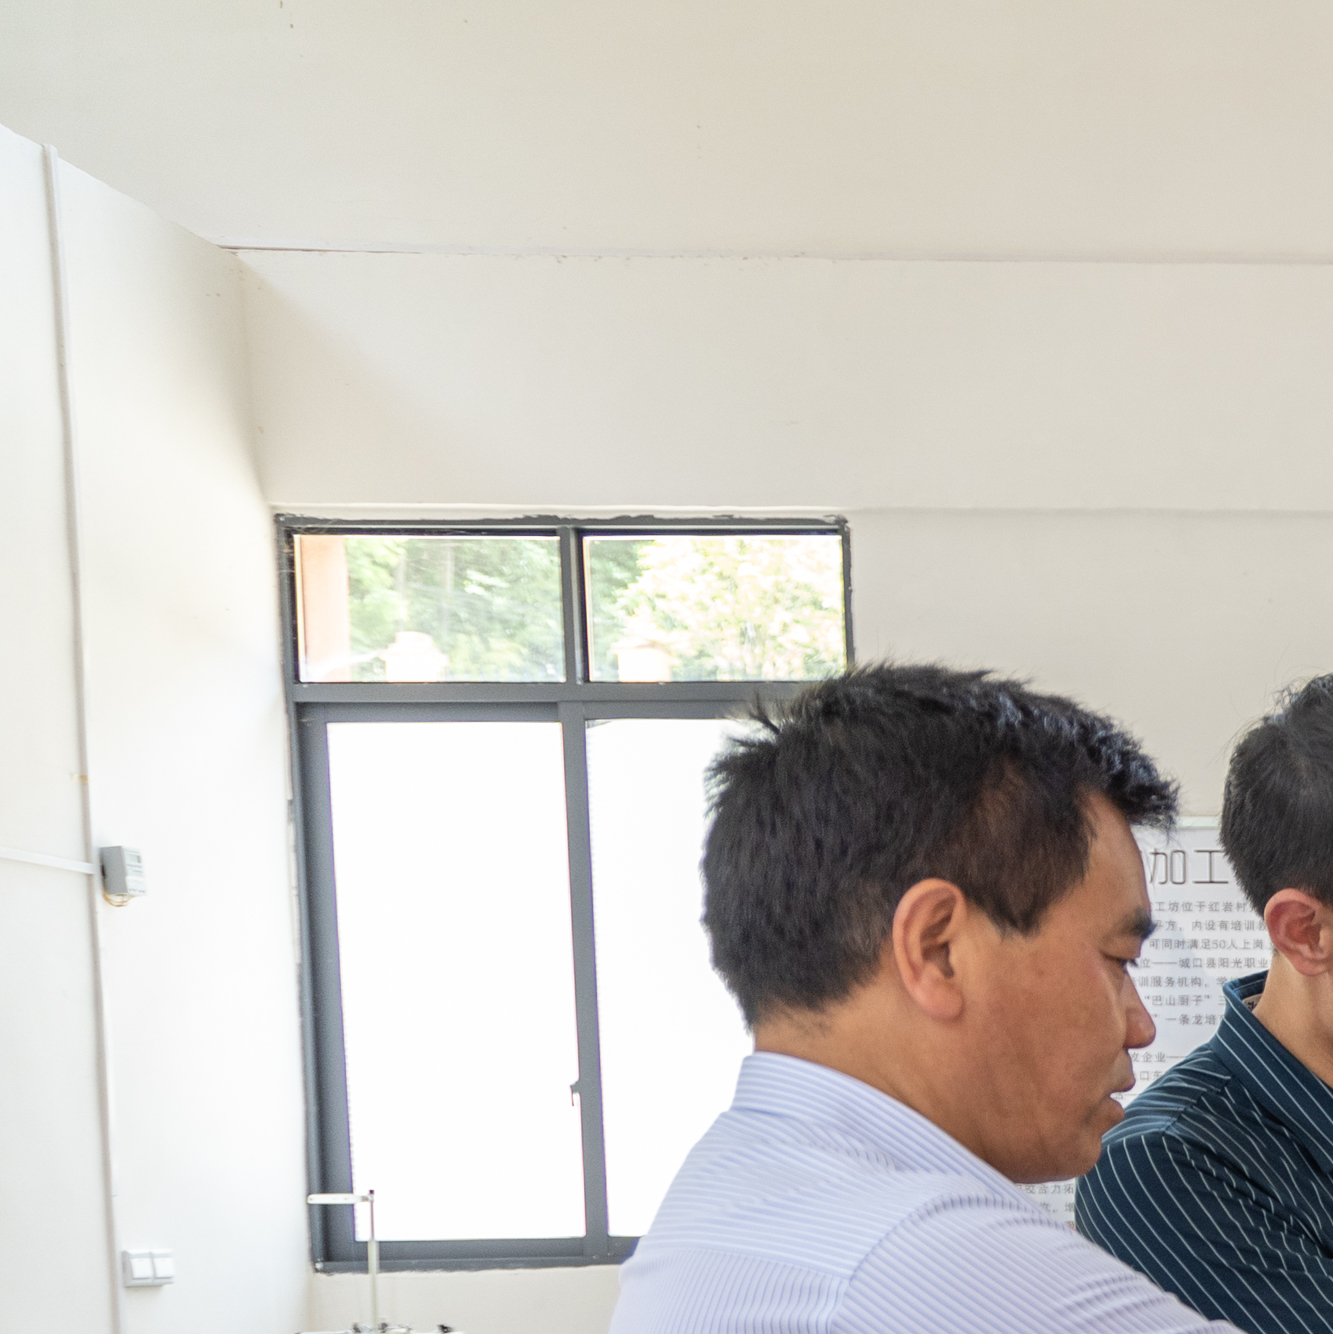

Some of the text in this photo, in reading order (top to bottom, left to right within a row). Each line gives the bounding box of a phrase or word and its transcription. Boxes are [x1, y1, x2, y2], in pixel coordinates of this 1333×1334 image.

[1149, 849, 1229, 885] 加工
[1129, 957, 1268, 969] 位——城口县阳光职业
